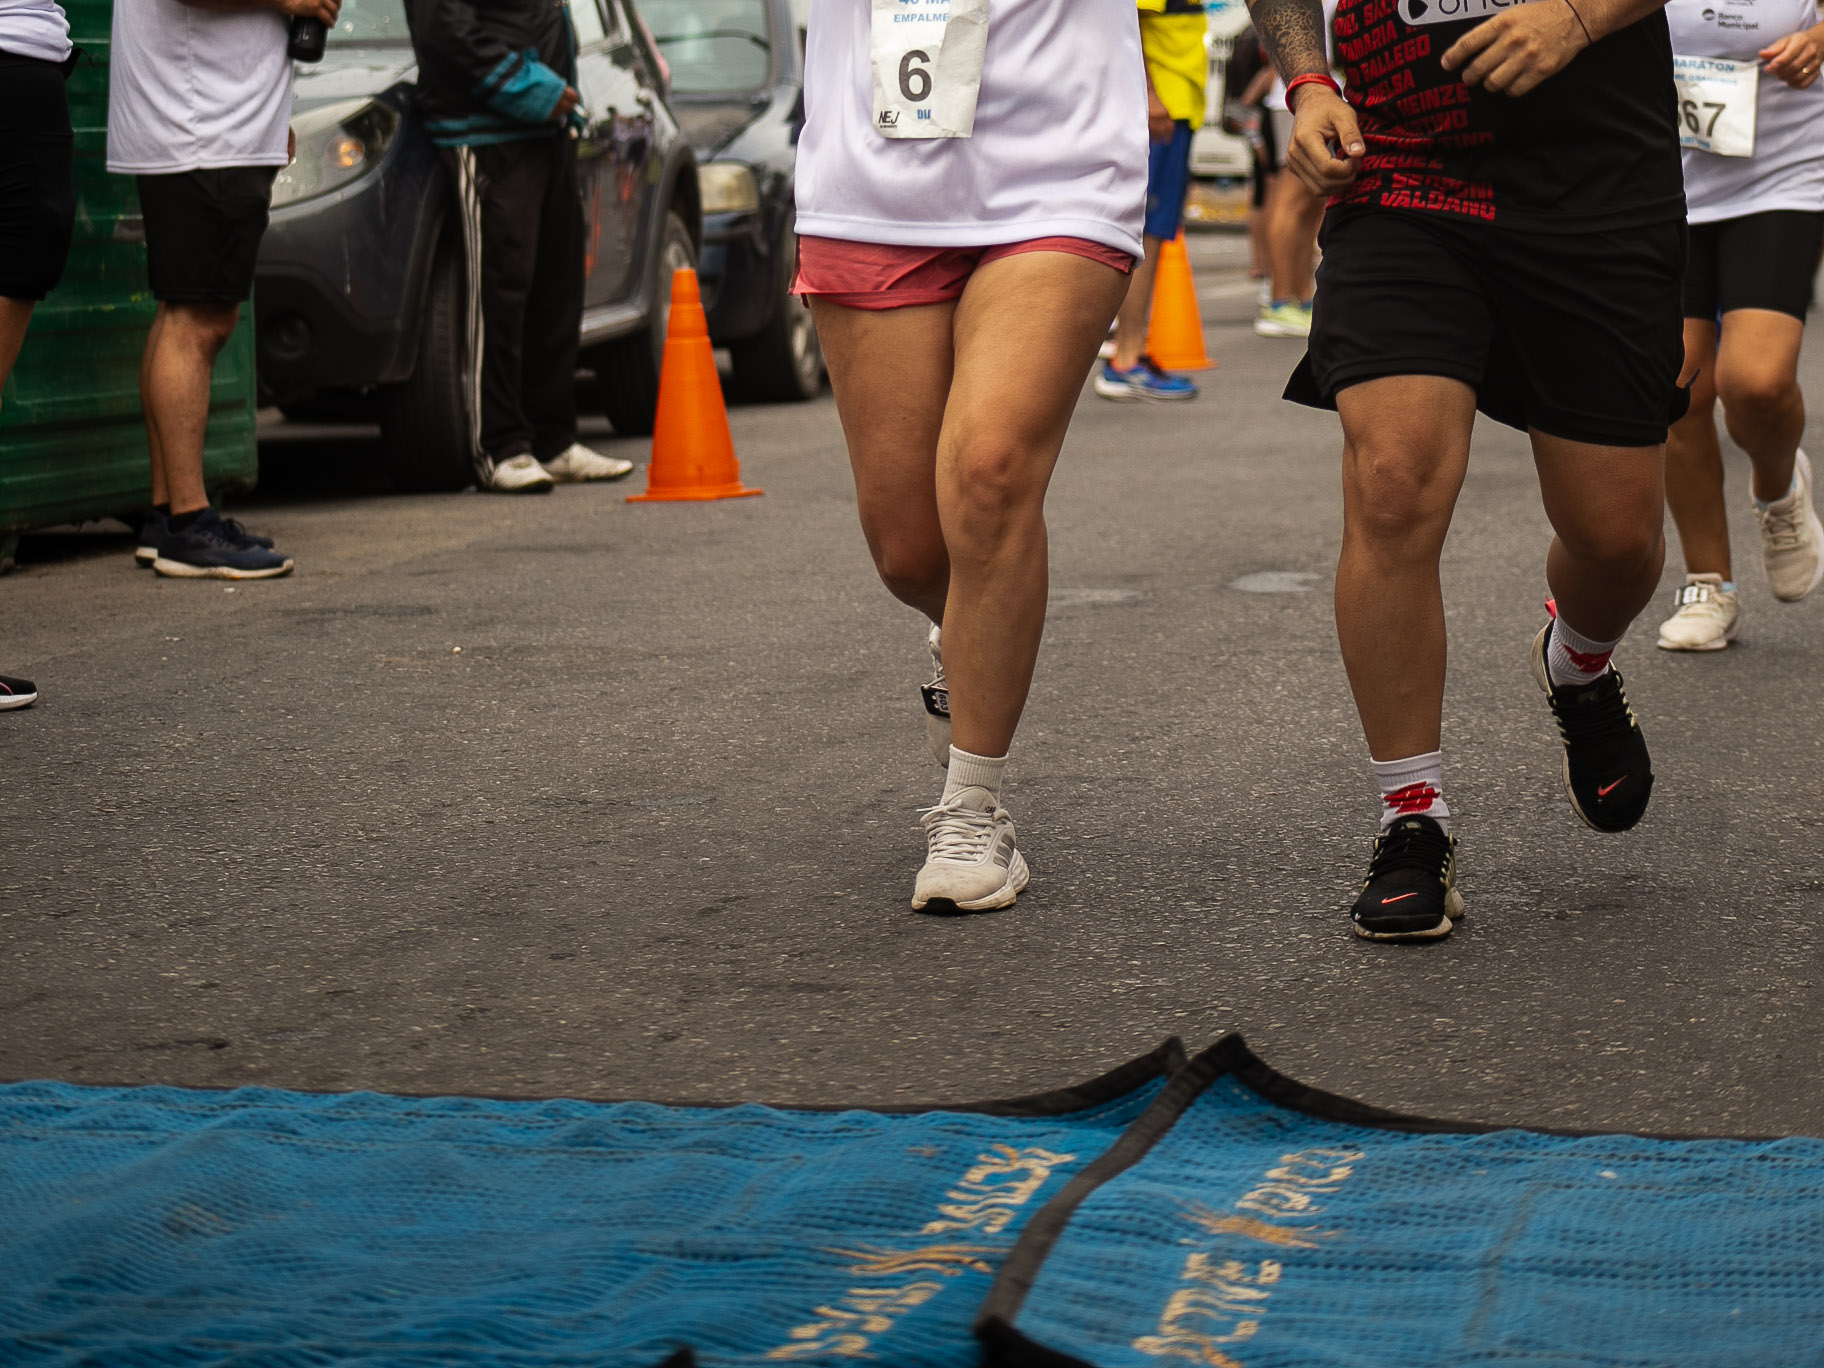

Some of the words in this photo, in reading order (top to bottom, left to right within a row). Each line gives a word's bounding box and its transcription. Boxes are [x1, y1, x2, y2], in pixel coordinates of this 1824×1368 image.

[893, 12, 950, 23] EMPALME
[898, 49, 933, 103] 6
[1678, 100, 1727, 138] 67
[1380, 191, 1496, 222] VALDANO
